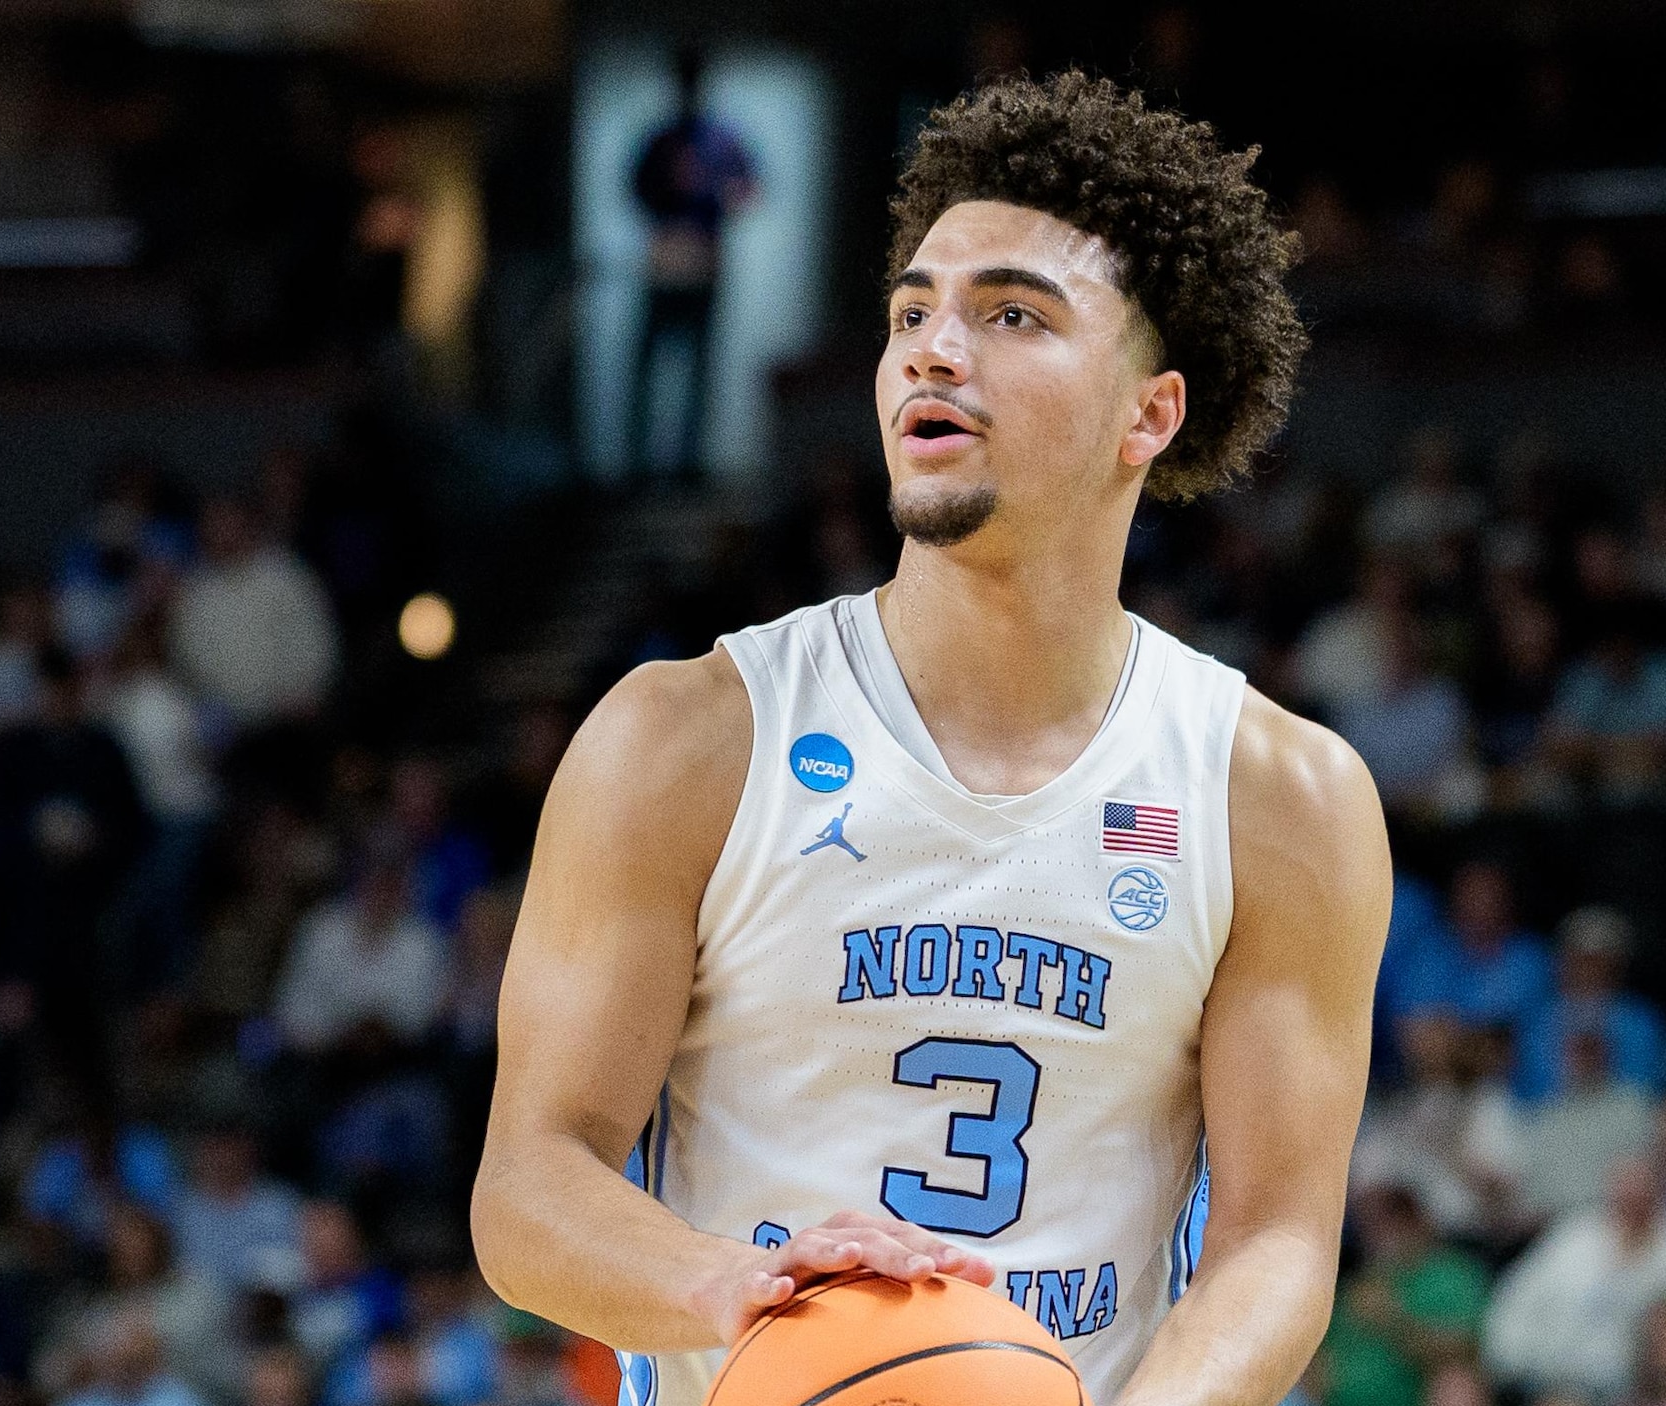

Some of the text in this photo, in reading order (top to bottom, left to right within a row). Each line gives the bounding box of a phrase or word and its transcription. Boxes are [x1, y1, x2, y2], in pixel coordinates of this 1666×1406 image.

[798, 756, 850, 782] NCAA
[1114, 887, 1165, 906] ACC
[837, 923, 1113, 1030] NORTH
[879, 1036, 1042, 1239] 3
